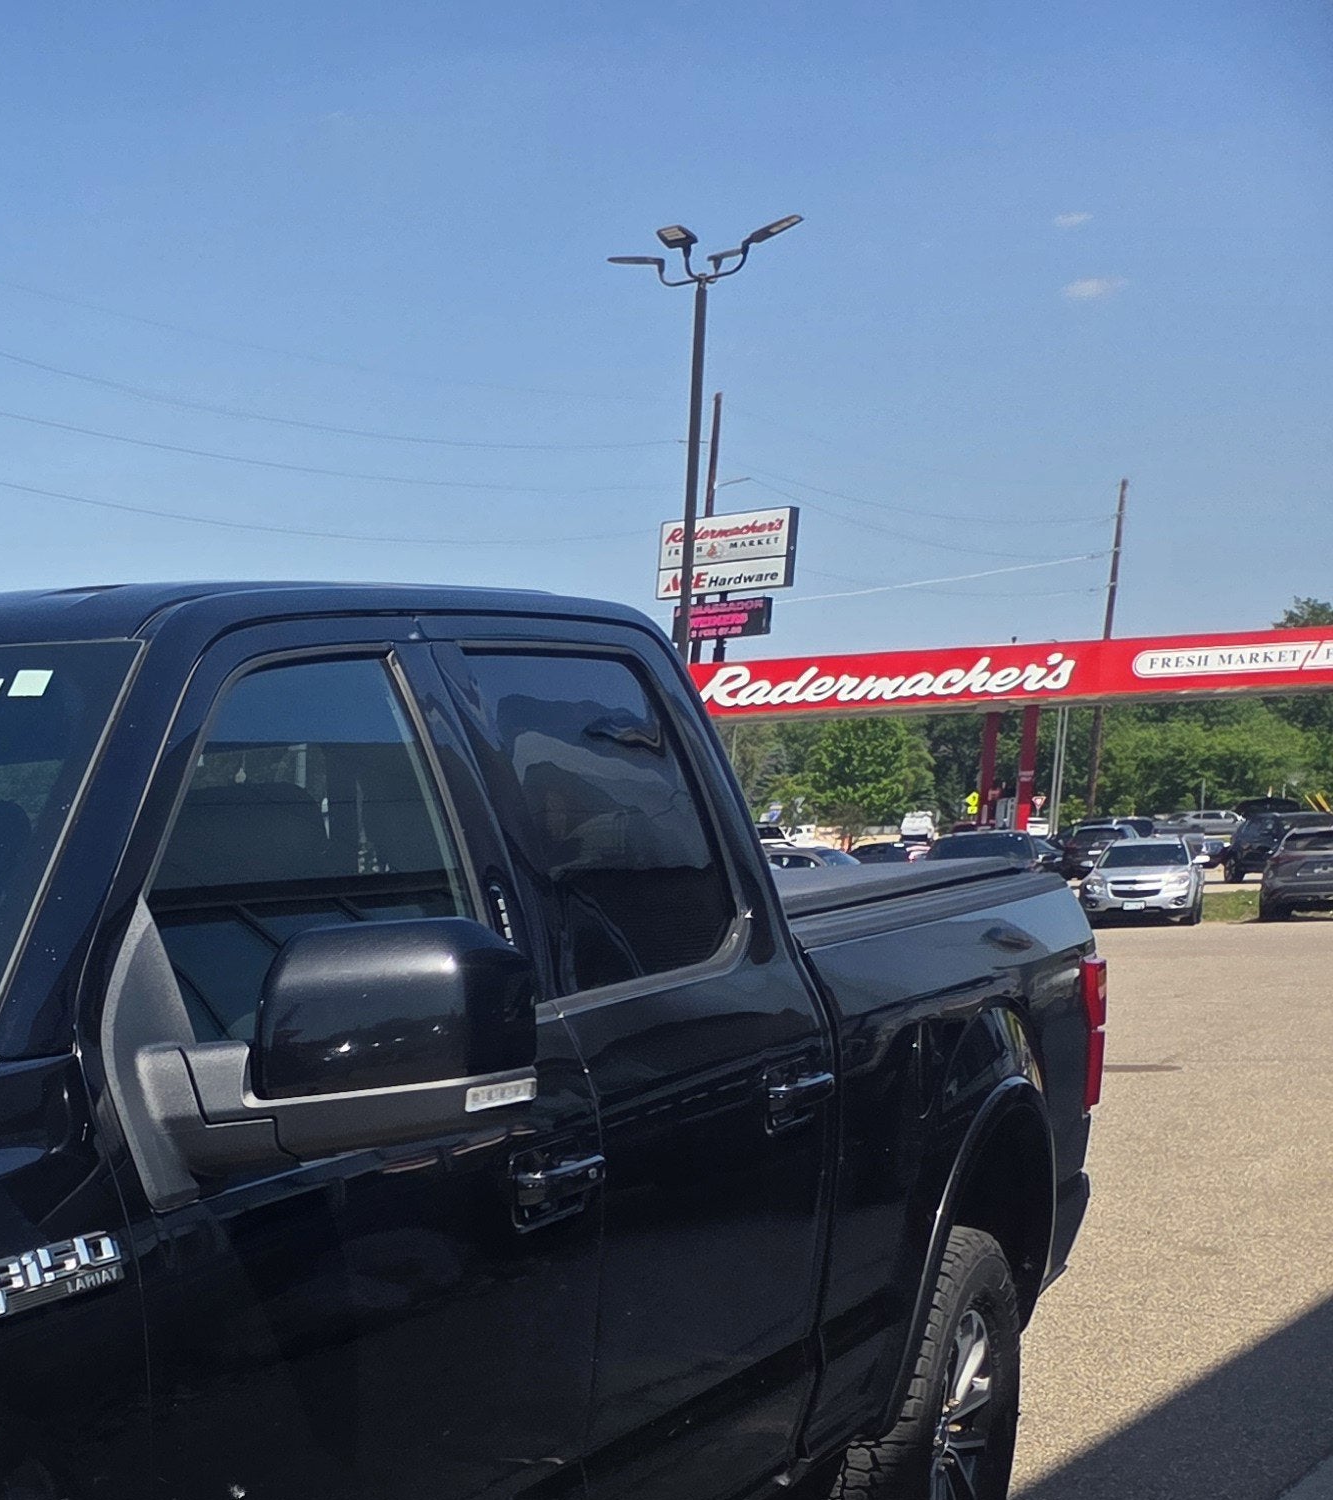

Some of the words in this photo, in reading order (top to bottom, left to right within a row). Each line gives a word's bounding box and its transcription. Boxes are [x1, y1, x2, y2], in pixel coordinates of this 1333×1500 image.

[729, 537, 780, 549] MARKET
[708, 572, 779, 588] Hardware
[1149, 653, 1209, 669] FRESH
[1218, 649, 1301, 666] MARKET
[702, 652, 1077, 708] Radermacher's
[66, 1268, 118, 1294] LARIAT
